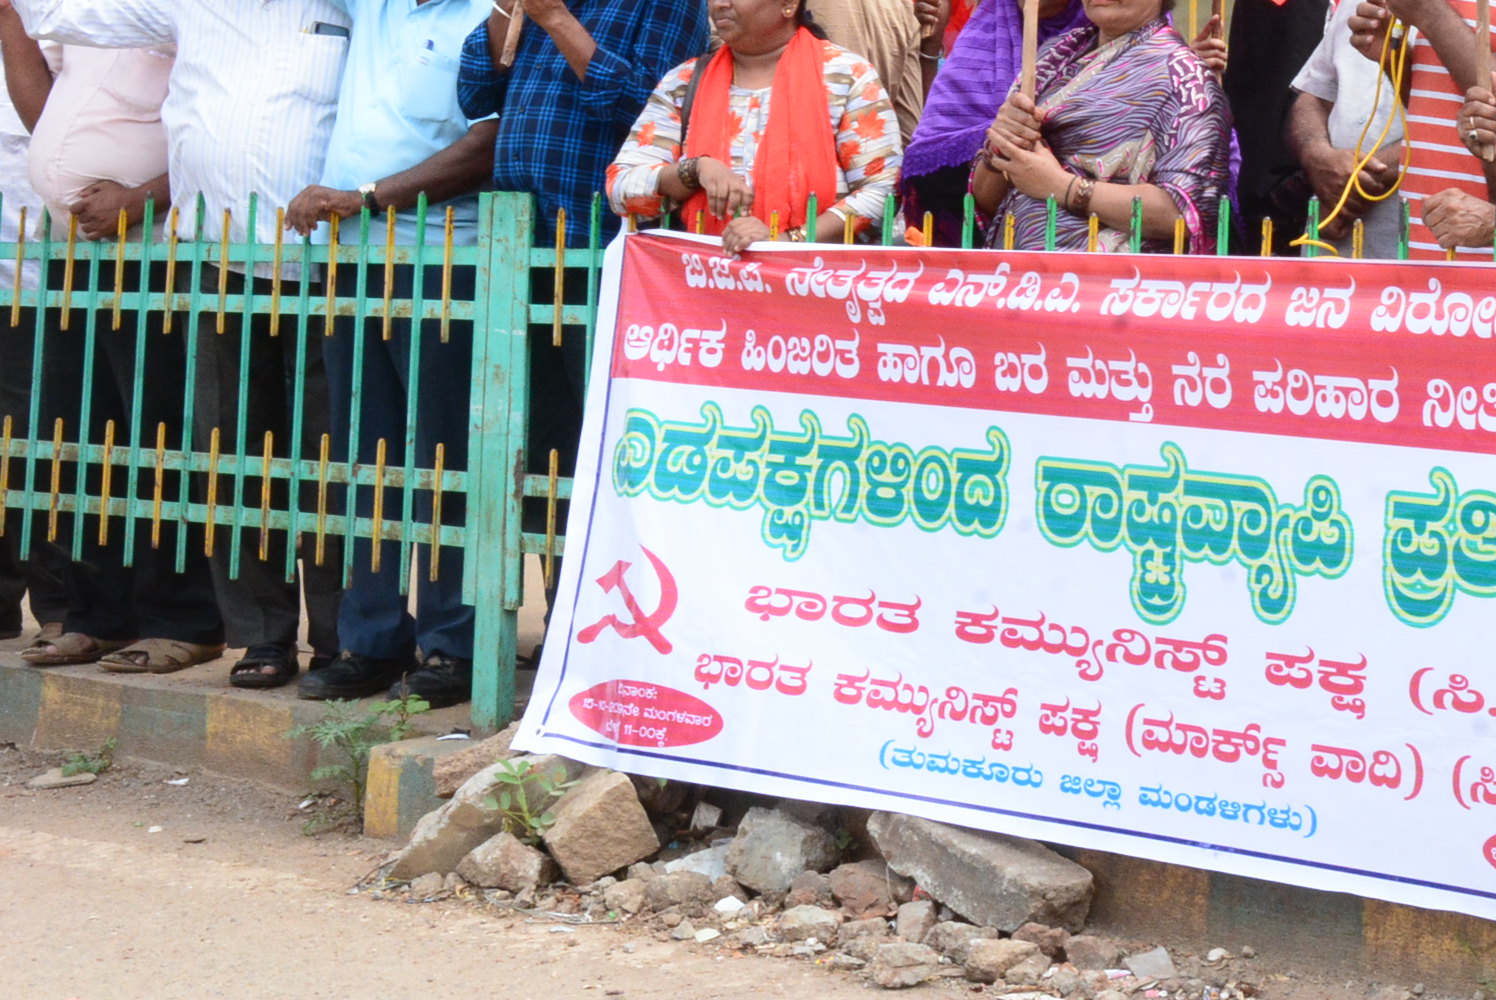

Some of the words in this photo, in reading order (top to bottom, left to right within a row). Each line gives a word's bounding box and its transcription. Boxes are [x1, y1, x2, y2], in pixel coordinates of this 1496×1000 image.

[784, 255, 925, 326] ನೇತೃತ್ವದ
[928, 262, 1081, 313] ಎನ್.ಡಿ.ಎ.
[1099, 264, 1273, 325] ಸರ್ಕಾರದ
[1284, 274, 1357, 330] ಜನ
[740, 328, 861, 380] ಹಿಂಜರಿತ
[876, 334, 977, 389] ಹಾಗೂ
[993, 341, 1050, 395] ಬರ
[1065, 345, 1155, 423] ಮತ್ತು
[1170, 351, 1233, 409] ನೆರೆ
[1251, 357, 1401, 424] ಪರಿಹಾರ
[613, 400, 1011, 563] ಎಡಪಕ್ಷಗಳಿಂದ
[744, 585, 922, 634] ಭಾರತ
[1264, 645, 1368, 720] ಪಕ್ಷ
[694, 652, 813, 697] ಭಾರತ
[1037, 695, 1102, 764] ಪಕ್ಷ
[1310, 742, 1424, 802] ವಾದಿ)
[879, 738, 1044, 789] (ತುಮಕೂರು
[1059, 773, 1123, 812] ಜಿಲ್ಲಾ
[1137, 781, 1319, 839] ಮಂಡಳಿಗಳು)
